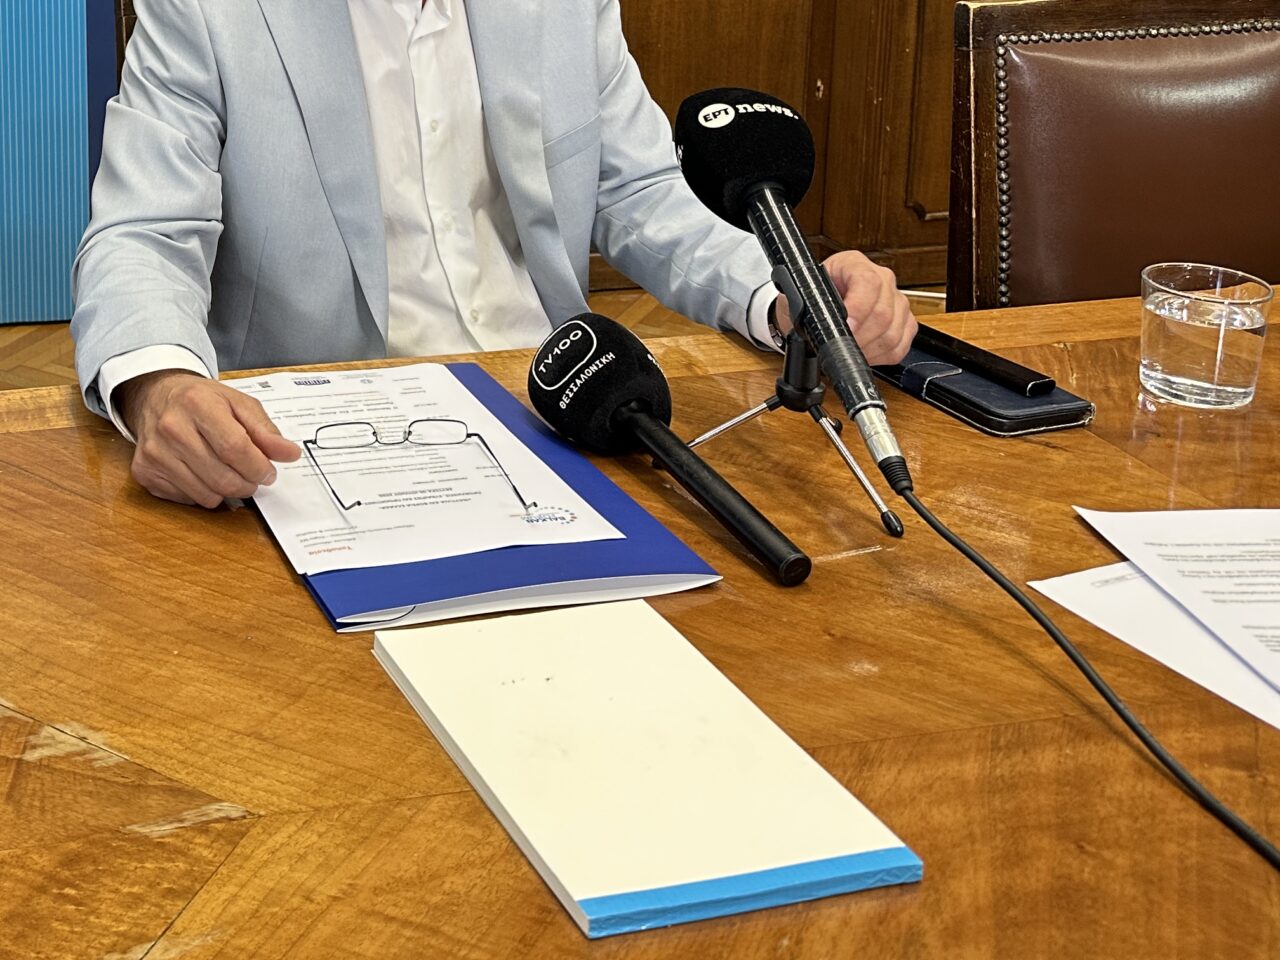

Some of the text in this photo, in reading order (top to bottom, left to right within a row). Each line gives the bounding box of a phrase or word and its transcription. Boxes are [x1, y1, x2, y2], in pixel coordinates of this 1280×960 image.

[703, 107, 730, 122] ΕΡΤ
[538, 329, 583, 373] TV100
[559, 351, 616, 409] ΘΕΣΣΑΛΟΝΙΚΗ
